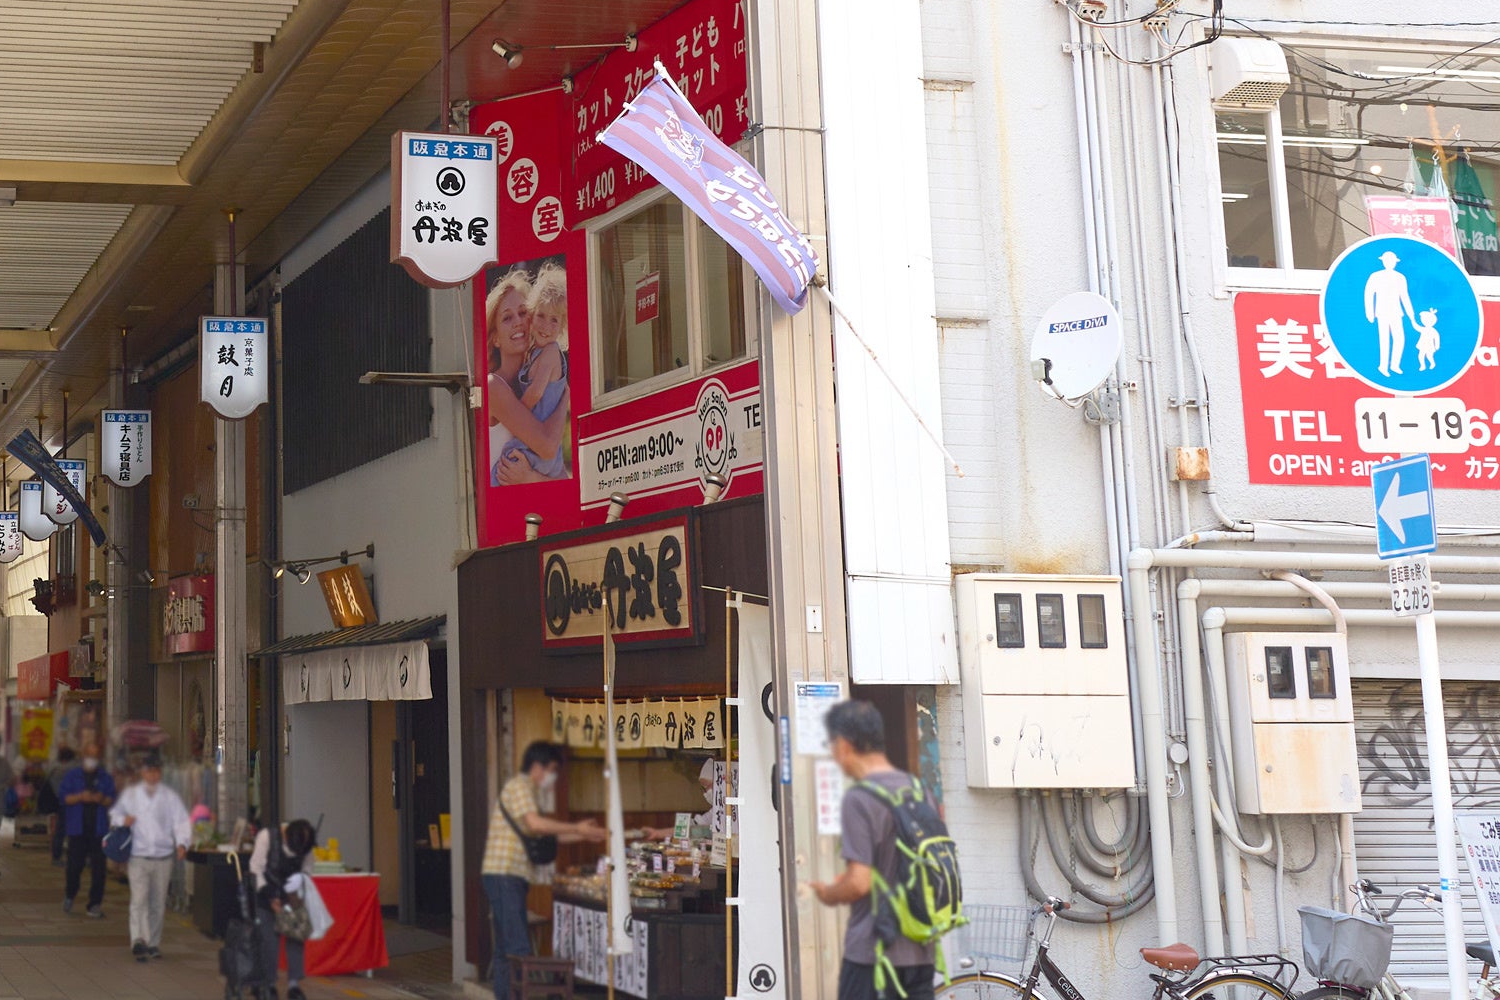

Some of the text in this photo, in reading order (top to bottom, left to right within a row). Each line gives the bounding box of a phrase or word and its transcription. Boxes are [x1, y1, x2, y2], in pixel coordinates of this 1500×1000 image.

[676, 15, 719, 68] 子ども
[577, 88, 612, 134] カット
[413, 141, 488, 159] 阪急本通
[411, 215, 489, 246] 丹波屋
[1389, 213, 1436, 227] 予約不要
[209, 322, 263, 333] 阪急本通
[1052, 319, 1082, 334] SPACE
[217, 344, 240, 398] 鼓月
[1263, 409, 1342, 442] TEL
[119, 424, 131, 481] キムラ寝具店
[1393, 585, 1430, 612] ここから
